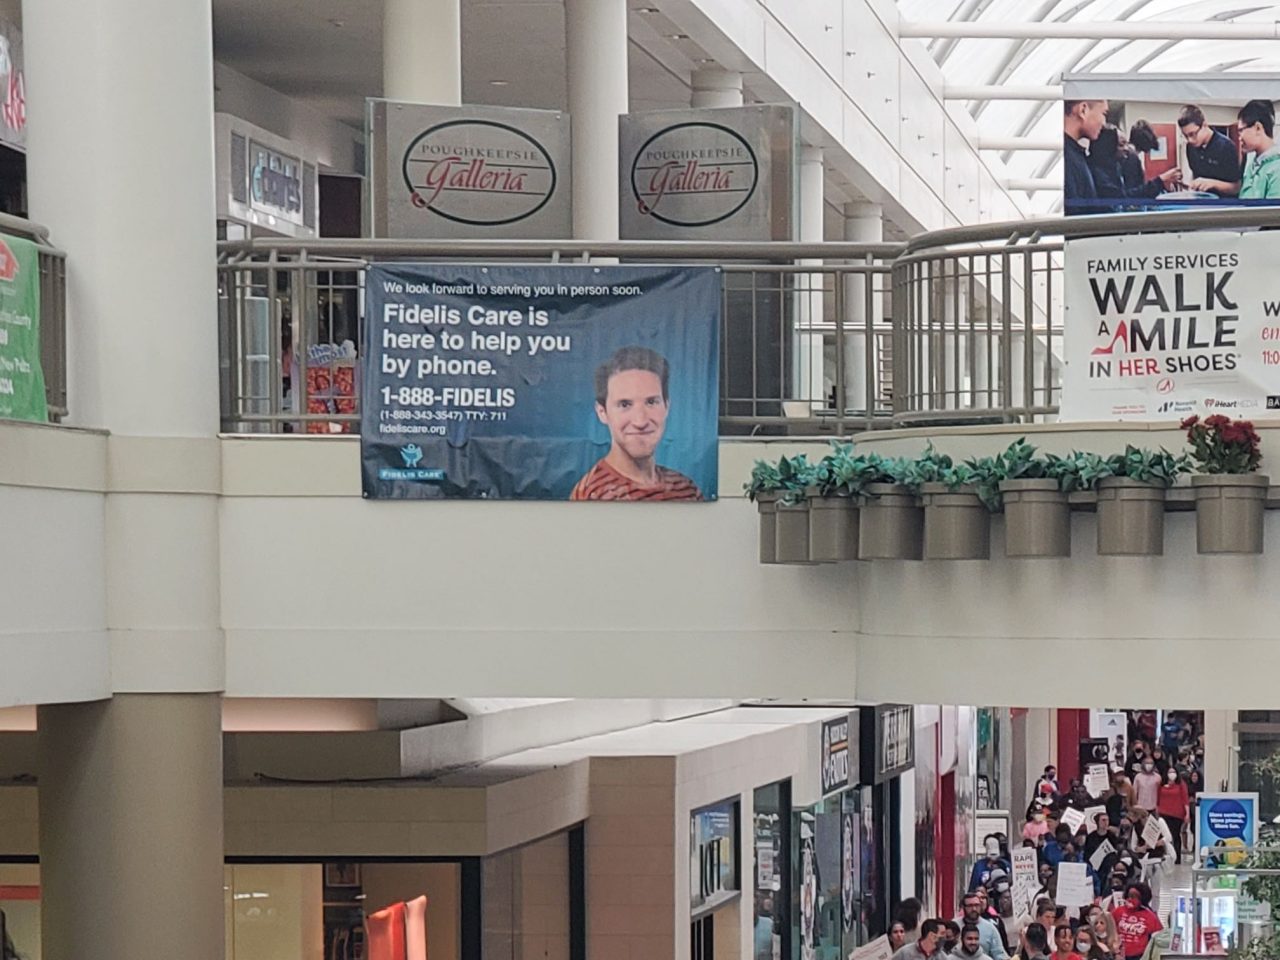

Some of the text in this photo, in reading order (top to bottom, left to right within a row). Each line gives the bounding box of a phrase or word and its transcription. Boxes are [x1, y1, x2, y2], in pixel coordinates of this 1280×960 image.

[421, 145, 539, 161] POUGHKEEPSIE
[646, 147, 745, 161] POUGHKEEPSIE
[416, 156, 528, 206] Galleria
[641, 160, 734, 213] Galleria
[1087, 253, 1239, 274] FAMILY SERVICES
[383, 281, 643, 298] We look forward to serving you in person soon.
[1088, 271, 1239, 316] WALK
[383, 303, 549, 327] Fidelis Care is
[382, 329, 571, 356] here to help you
[1097, 315, 1239, 353] A MILE
[382, 353, 497, 379] by phone.
[1089, 353, 1237, 378] IN HER SHOES
[380, 386, 516, 407] 1-888-FIDELIS
[466, 410, 489, 421] TTY:
[490, 412, 507, 421] 711
[379, 423, 446, 435] fideliscare.org
[418, 470, 440, 479] CARE
